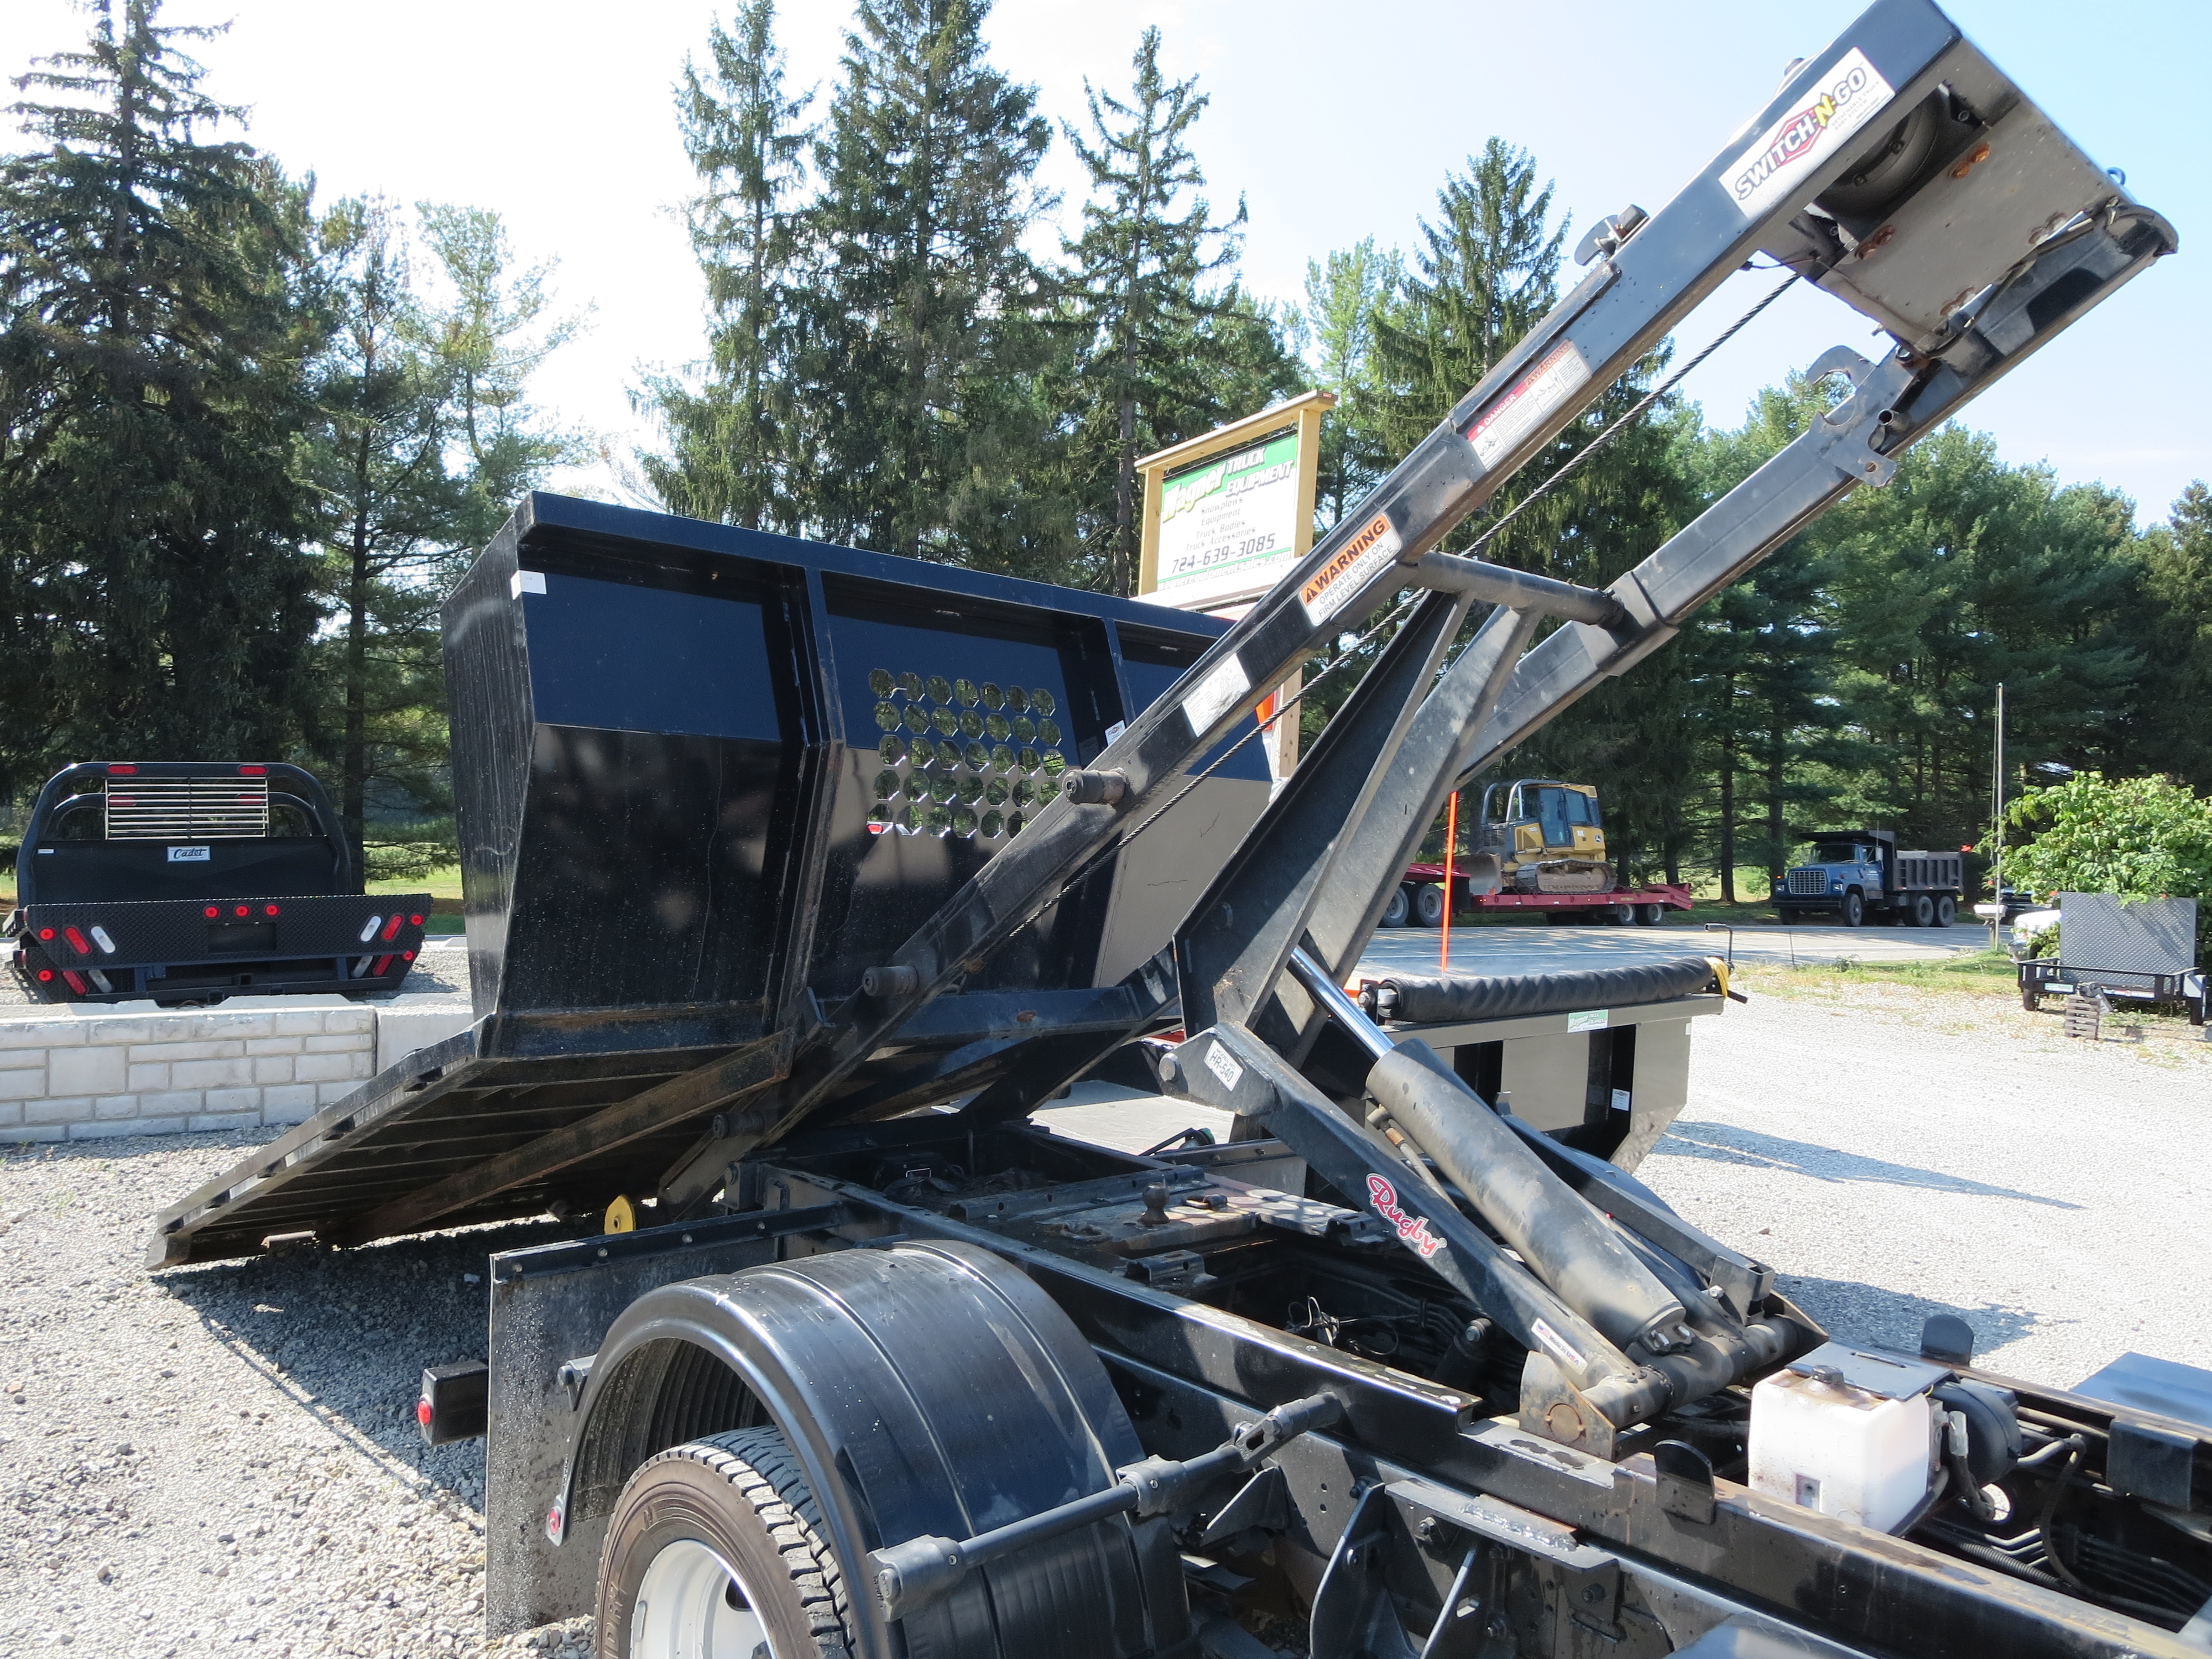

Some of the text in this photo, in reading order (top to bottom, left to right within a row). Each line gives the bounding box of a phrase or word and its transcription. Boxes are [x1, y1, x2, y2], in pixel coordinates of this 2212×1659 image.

[1532, 342, 1570, 378] WARNING
[1484, 393, 1517, 426] DANGER
[1162, 447, 1266, 523] Wagner TRUCK
[1225, 458, 1295, 498] EQUIPMENT
[1196, 520, 1245, 539] Truck Bodies
[1201, 508, 1241, 526] Equipment
[1172, 533, 1276, 574] 724-639-3085
[1186, 527, 1256, 552] Truck Accessories
[1314, 520, 1385, 589] WARNING
[1318, 544, 1394, 618] FIRM LEVEL SURFACE
[1319, 541, 1384, 604] OPERATE ONLY ON
[174, 848, 207, 859] Cadet
[1209, 1051, 1234, 1082] HR-540
[1217, 1047, 1228, 1063] MODEL
[1367, 1175, 1439, 1258] Rugby
[1566, 1351, 1580, 1366] USA
